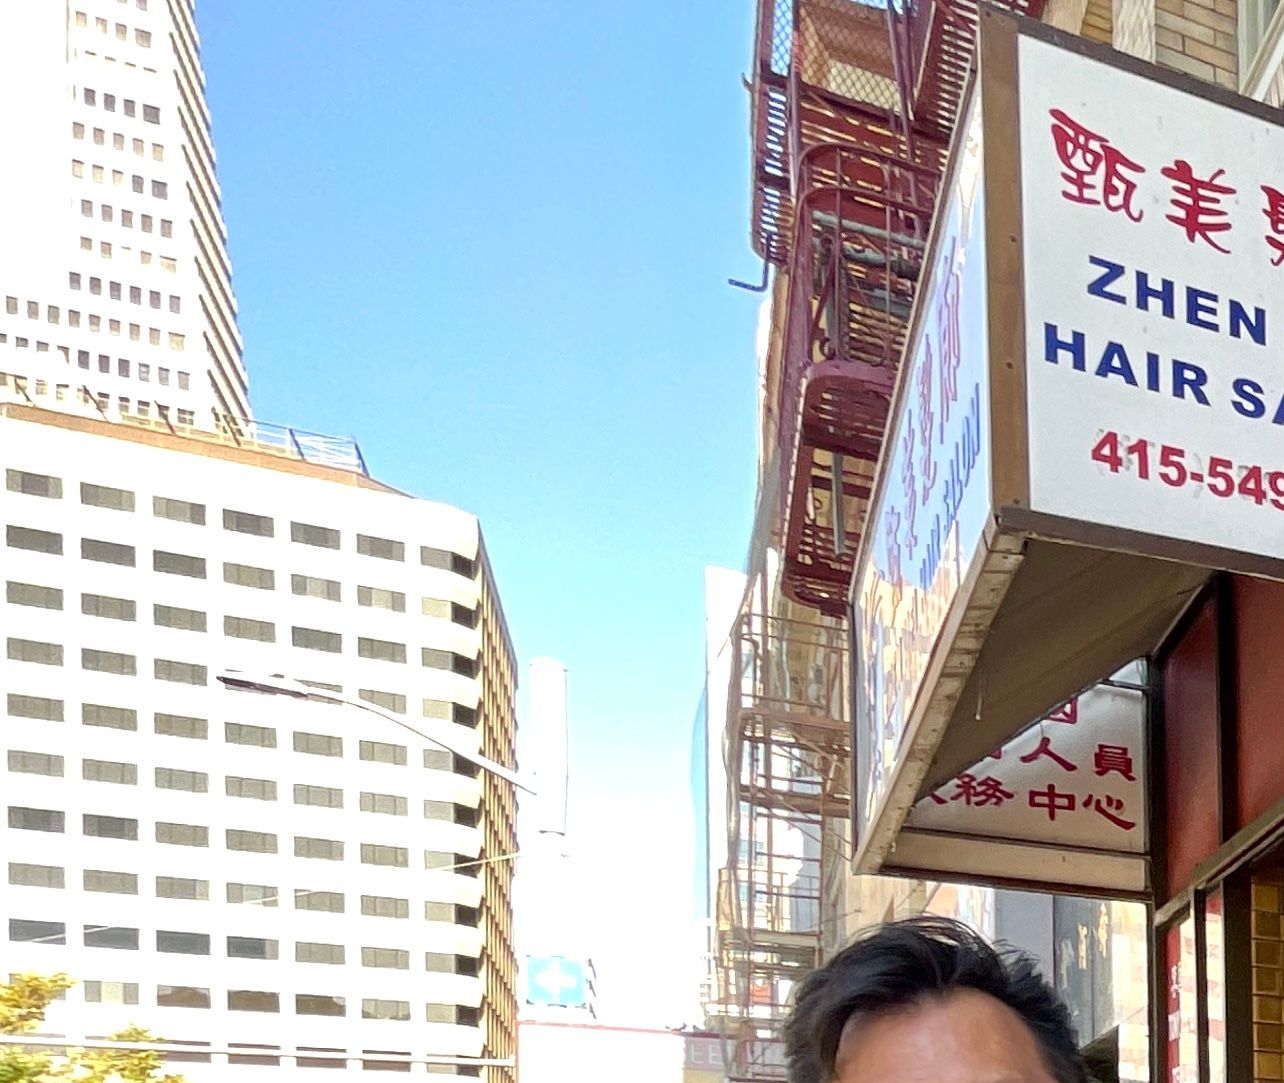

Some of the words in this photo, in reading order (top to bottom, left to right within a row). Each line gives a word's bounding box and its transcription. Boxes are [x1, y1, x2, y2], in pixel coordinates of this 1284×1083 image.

[1086, 254, 1267, 347] ZHEN
[1044, 322, 1212, 406] HAIR
[985, 737, 1137, 782] 人員
[928, 772, 1136, 831] 務中心
